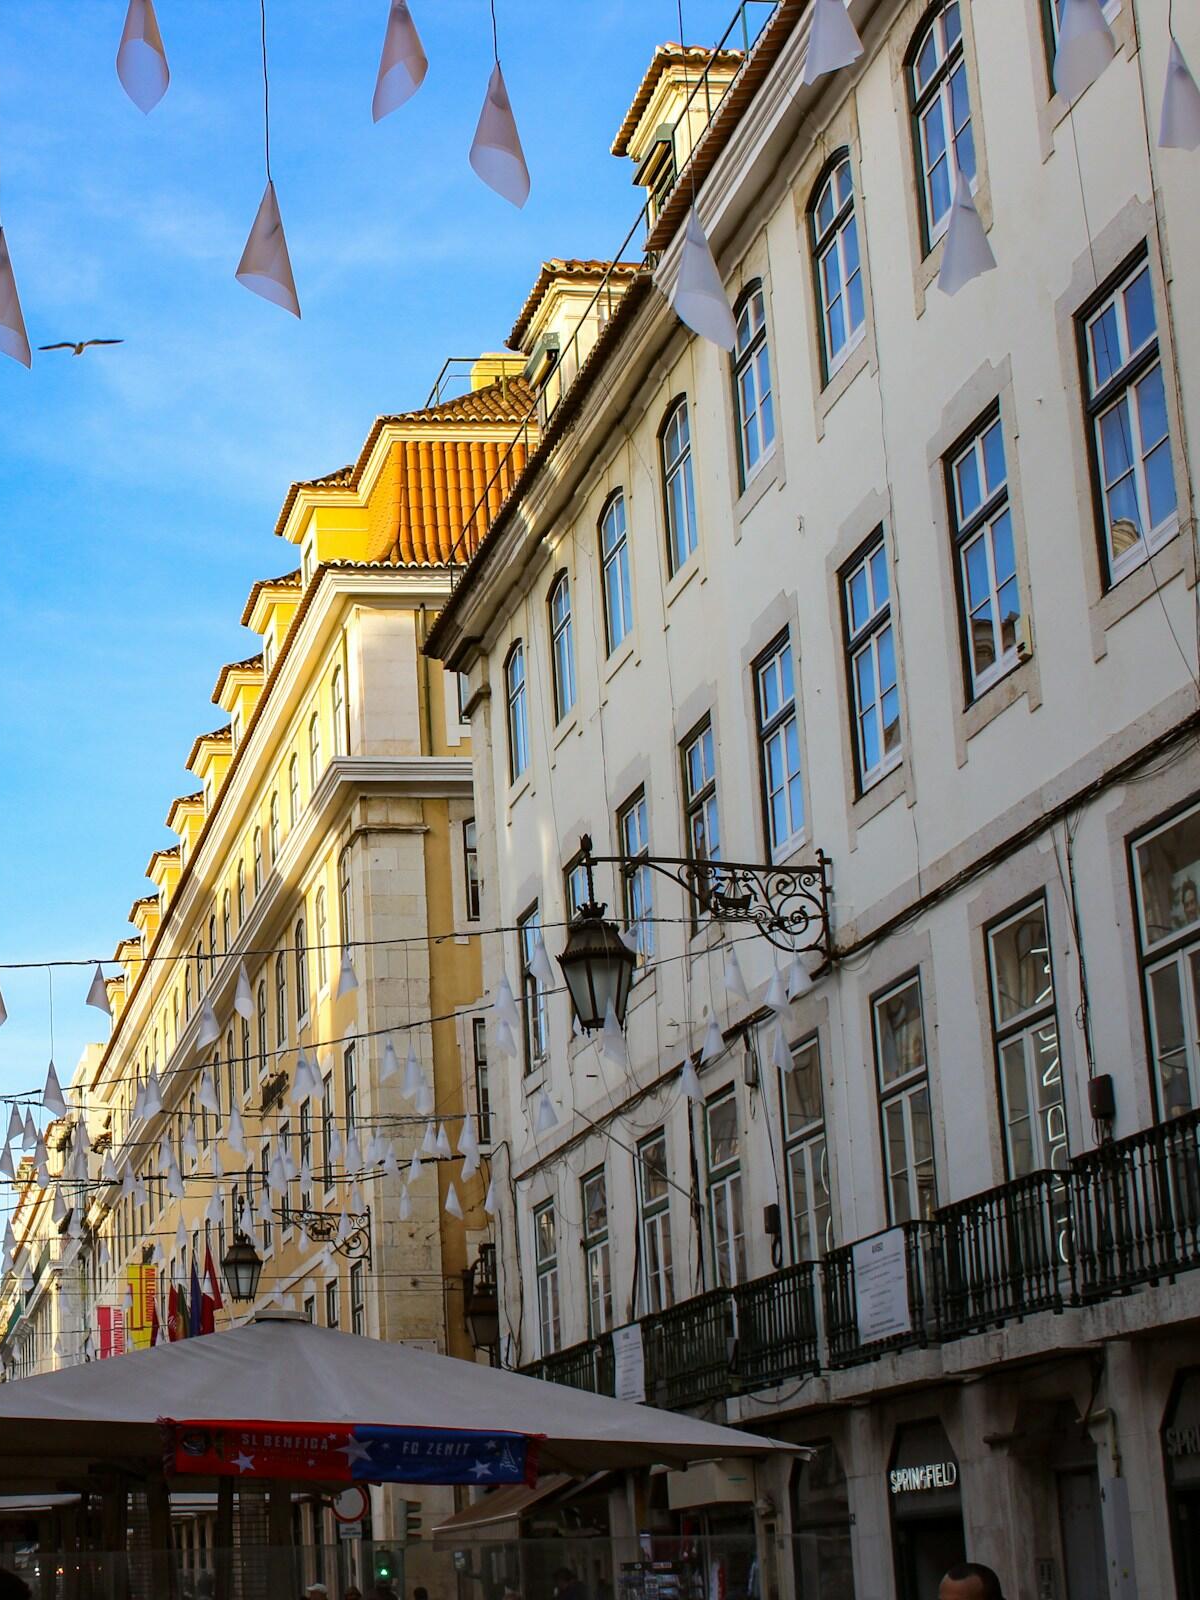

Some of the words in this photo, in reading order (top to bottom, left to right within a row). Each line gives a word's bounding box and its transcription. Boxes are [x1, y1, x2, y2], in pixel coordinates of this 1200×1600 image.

[240, 1433, 258, 1446] SL
[426, 1442, 471, 1456] ZENIT
[890, 1461, 957, 1494] SPRINGFIELD
